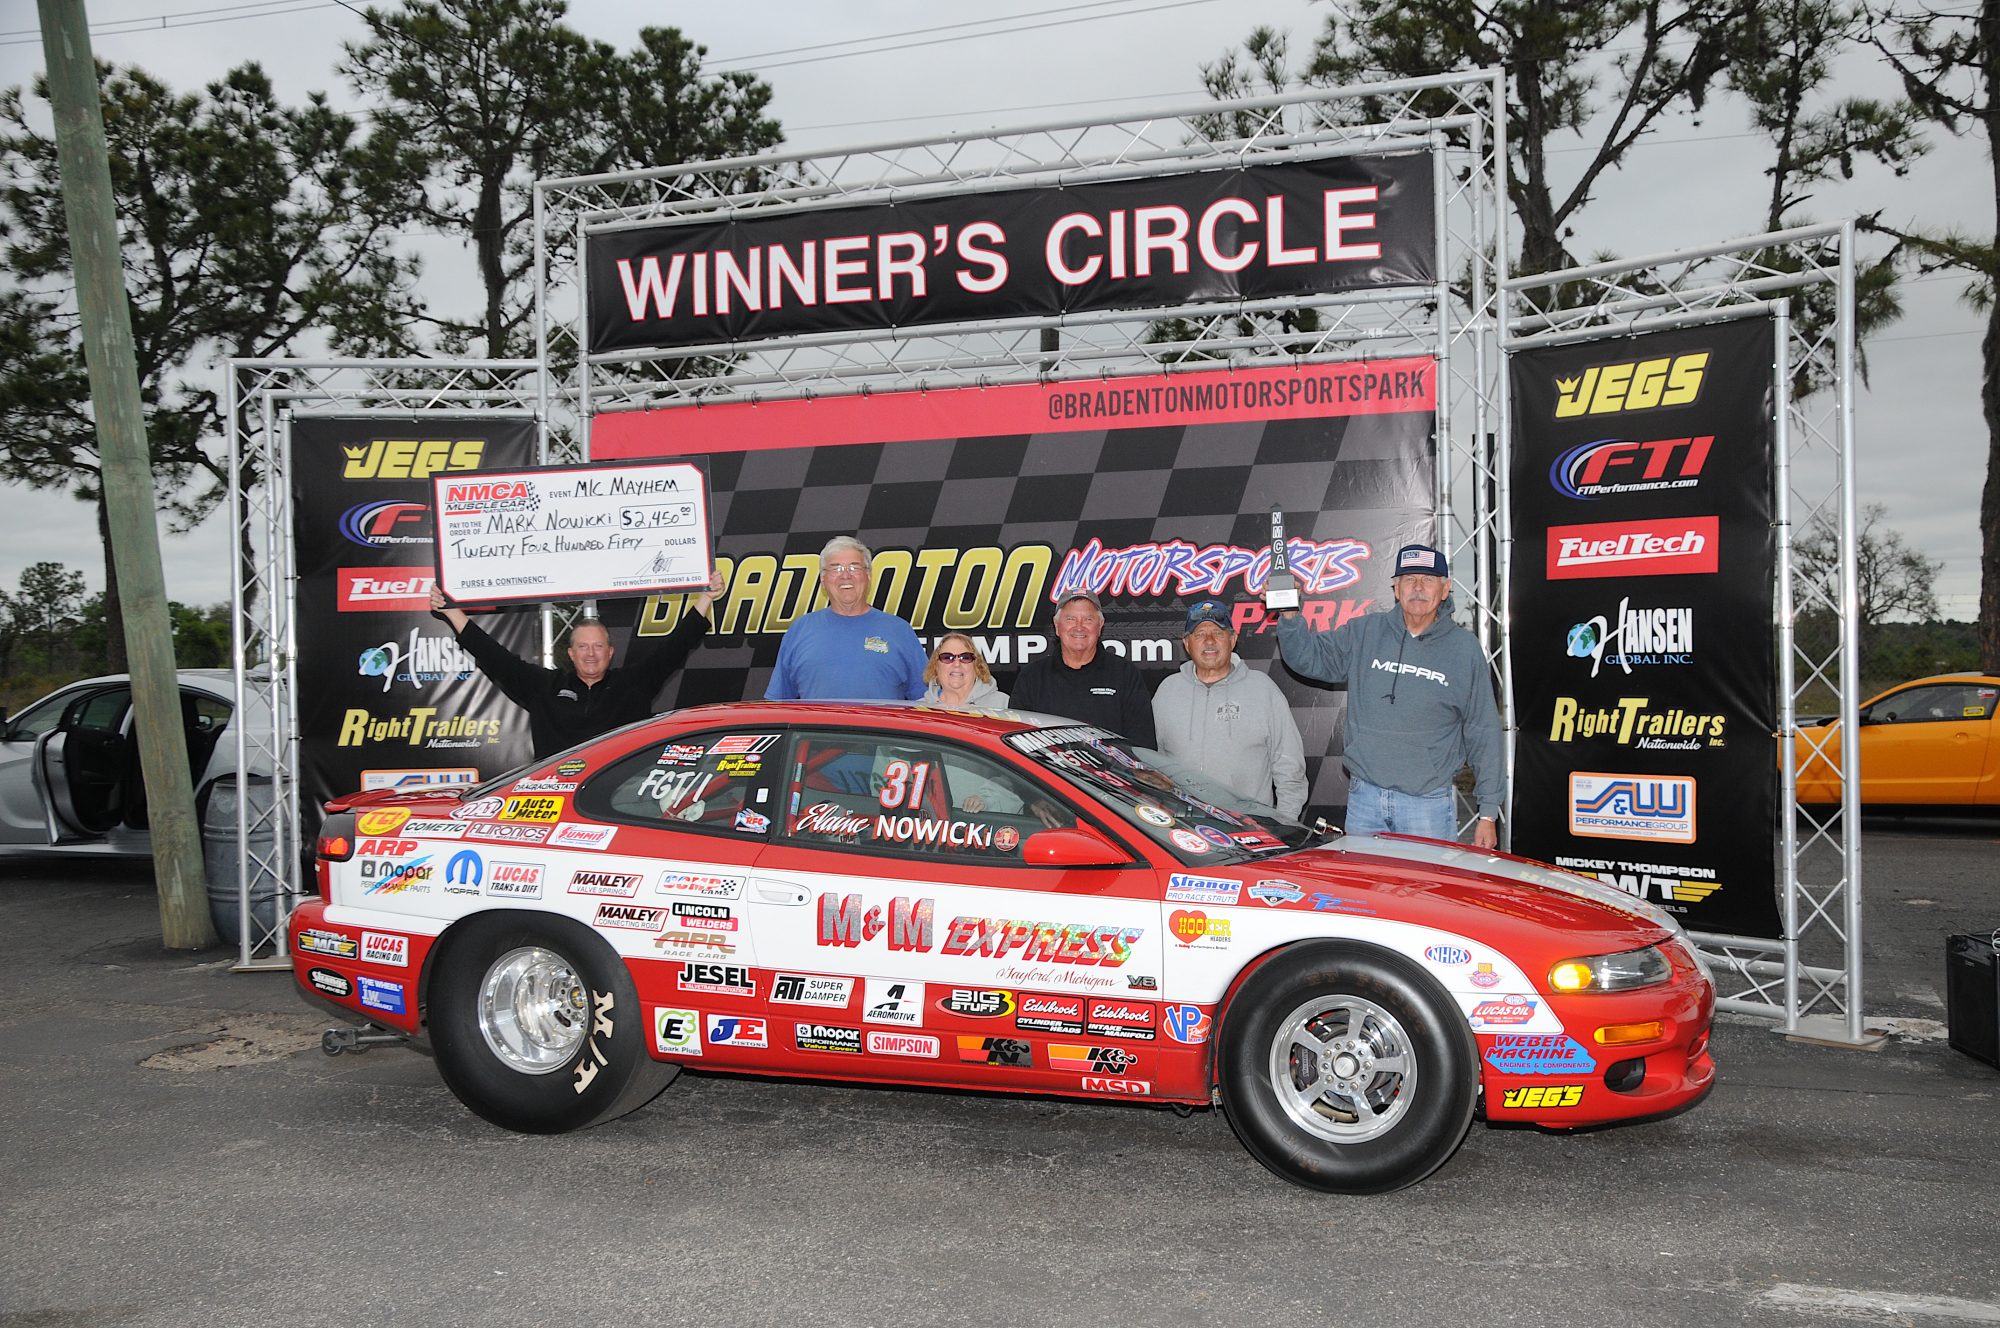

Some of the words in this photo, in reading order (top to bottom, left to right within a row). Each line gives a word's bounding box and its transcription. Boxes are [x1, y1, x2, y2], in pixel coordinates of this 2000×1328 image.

[616, 220, 1010, 321] WINNER'S
[1046, 185, 1383, 285] CIRCLE
[1554, 352, 1710, 418] JEGS
[1048, 370, 1425, 420] @BRADENTONMOTORSPORTSPARK
[342, 440, 486, 479] JEGS
[1580, 436, 1716, 485] FTI
[446, 483, 528, 501] NMCA
[549, 491, 571, 499] EVENT
[609, 476, 679, 497] MAYHEM
[1576, 479, 1699, 495] FTIPerformance.com
[446, 501, 492, 511] MUSCLE
[502, 500, 526, 508] CAR
[485, 514, 537, 534] MARK
[451, 538, 516, 559] TWENTY
[521, 535, 550, 556] FOUR
[555, 535, 604, 552] HUNDRED
[664, 537, 696, 546] DOLLARS
[1272, 512, 1286, 570] NMCA
[1558, 531, 1705, 558] FuelTech
[461, 580, 484, 588] PURSE
[495, 576, 547, 586] CONTINGENCY
[637, 547, 1052, 637] BADNTON
[1567, 597, 1693, 678] HANSEN
[1605, 653, 1661, 665] GLOBAL
[1665, 654, 1693, 664] INC.
[397, 673, 446, 682] GLOBAL
[338, 708, 501, 747] RightTrailers
[1550, 697, 1726, 744] RightTrailers
[425, 738, 481, 748] Nationwide
[1635, 737, 1702, 750] Nationwide
[1709, 738, 1725, 747] Inc.
[880, 761, 930, 810] 31
[522, 798, 555, 810] Auto
[517, 808, 558, 820] Meter
[800, 804, 871, 833] Elaine
[404, 822, 467, 832] COMETIC
[557, 827, 607, 842] SUMMIT
[876, 814, 993, 848] NOWICKI
[357, 840, 417, 856] ARP
[380, 861, 433, 880] Mopar
[494, 866, 539, 883] LUCAS
[1555, 856, 1614, 870] MICKEY
[1617, 860, 1716, 879] THOMPSON
[361, 881, 409, 892] PERFORMANCE
[490, 883, 514, 892] TRANS
[523, 885, 538, 893] DIFF
[573, 873, 631, 888] MANLEY
[1171, 876, 1239, 891] Strange
[444, 887, 479, 896] MOPAR
[598, 888, 628, 896] SPRINGS
[1167, 892, 1185, 900] PRO
[1187, 893, 1207, 901] RACE
[1207, 894, 1236, 903] STRUTS
[598, 906, 656, 921] MANLEY
[674, 904, 728, 919] LINCOLN
[598, 919, 639, 928] CONNECTING
[686, 918, 733, 930] WELDERS
[1178, 917, 1232, 936] HOOKER
[314, 938, 340, 952] M/T
[366, 936, 404, 953] LUCAS
[940, 915, 1145, 968] EXPRESS
[366, 949, 390, 960] RACING
[392, 954, 403, 962] OIL
[1430, 947, 1466, 963] NHRA
[680, 963, 753, 988] JESEL
[1055, 970, 1121, 990] Michigan
[1126, 974, 1156, 987] V8
[685, 983, 716, 991] VALVETRAIN
[774, 976, 804, 1001] ATI
[810, 980, 843, 991] SUPER
[804, 991, 847, 1003] DAMPER
[951, 989, 1000, 1004] BIG
[951, 1001, 1000, 1013] STUFF
[1023, 999, 1078, 1017] Edelbrock
[1092, 1005, 1150, 1023] Edelbrock
[1476, 1005, 1511, 1016] LUCAS
[1513, 1006, 1530, 1016] OIL
[866, 1010, 916, 1022] AEROMOTIVE
[1017, 1017, 1063, 1027] CYLINDER
[1166, 1005, 1202, 1042] VP
[662, 1010, 697, 1040] E3
[710, 1019, 764, 1042] JE
[1049, 1026, 1082, 1034] HEADS
[1088, 1023, 1123, 1032] INTAKE
[813, 1025, 859, 1041] Mopar
[1104, 1030, 1155, 1040] MANIFOLD
[797, 1037, 860, 1048] PERFORMANCE
[803, 1043, 827, 1051] Valve
[830, 1045, 857, 1053] Covers
[873, 1036, 933, 1053] SIMPSON
[1497, 1036, 1568, 1047] WEBER
[659, 1045, 679, 1053] Spark
[681, 1047, 701, 1055] Plugs
[1487, 1048, 1577, 1059] MACHINE
[1087, 1046, 1138, 1075] K&N
[1085, 1078, 1146, 1094] MSD
